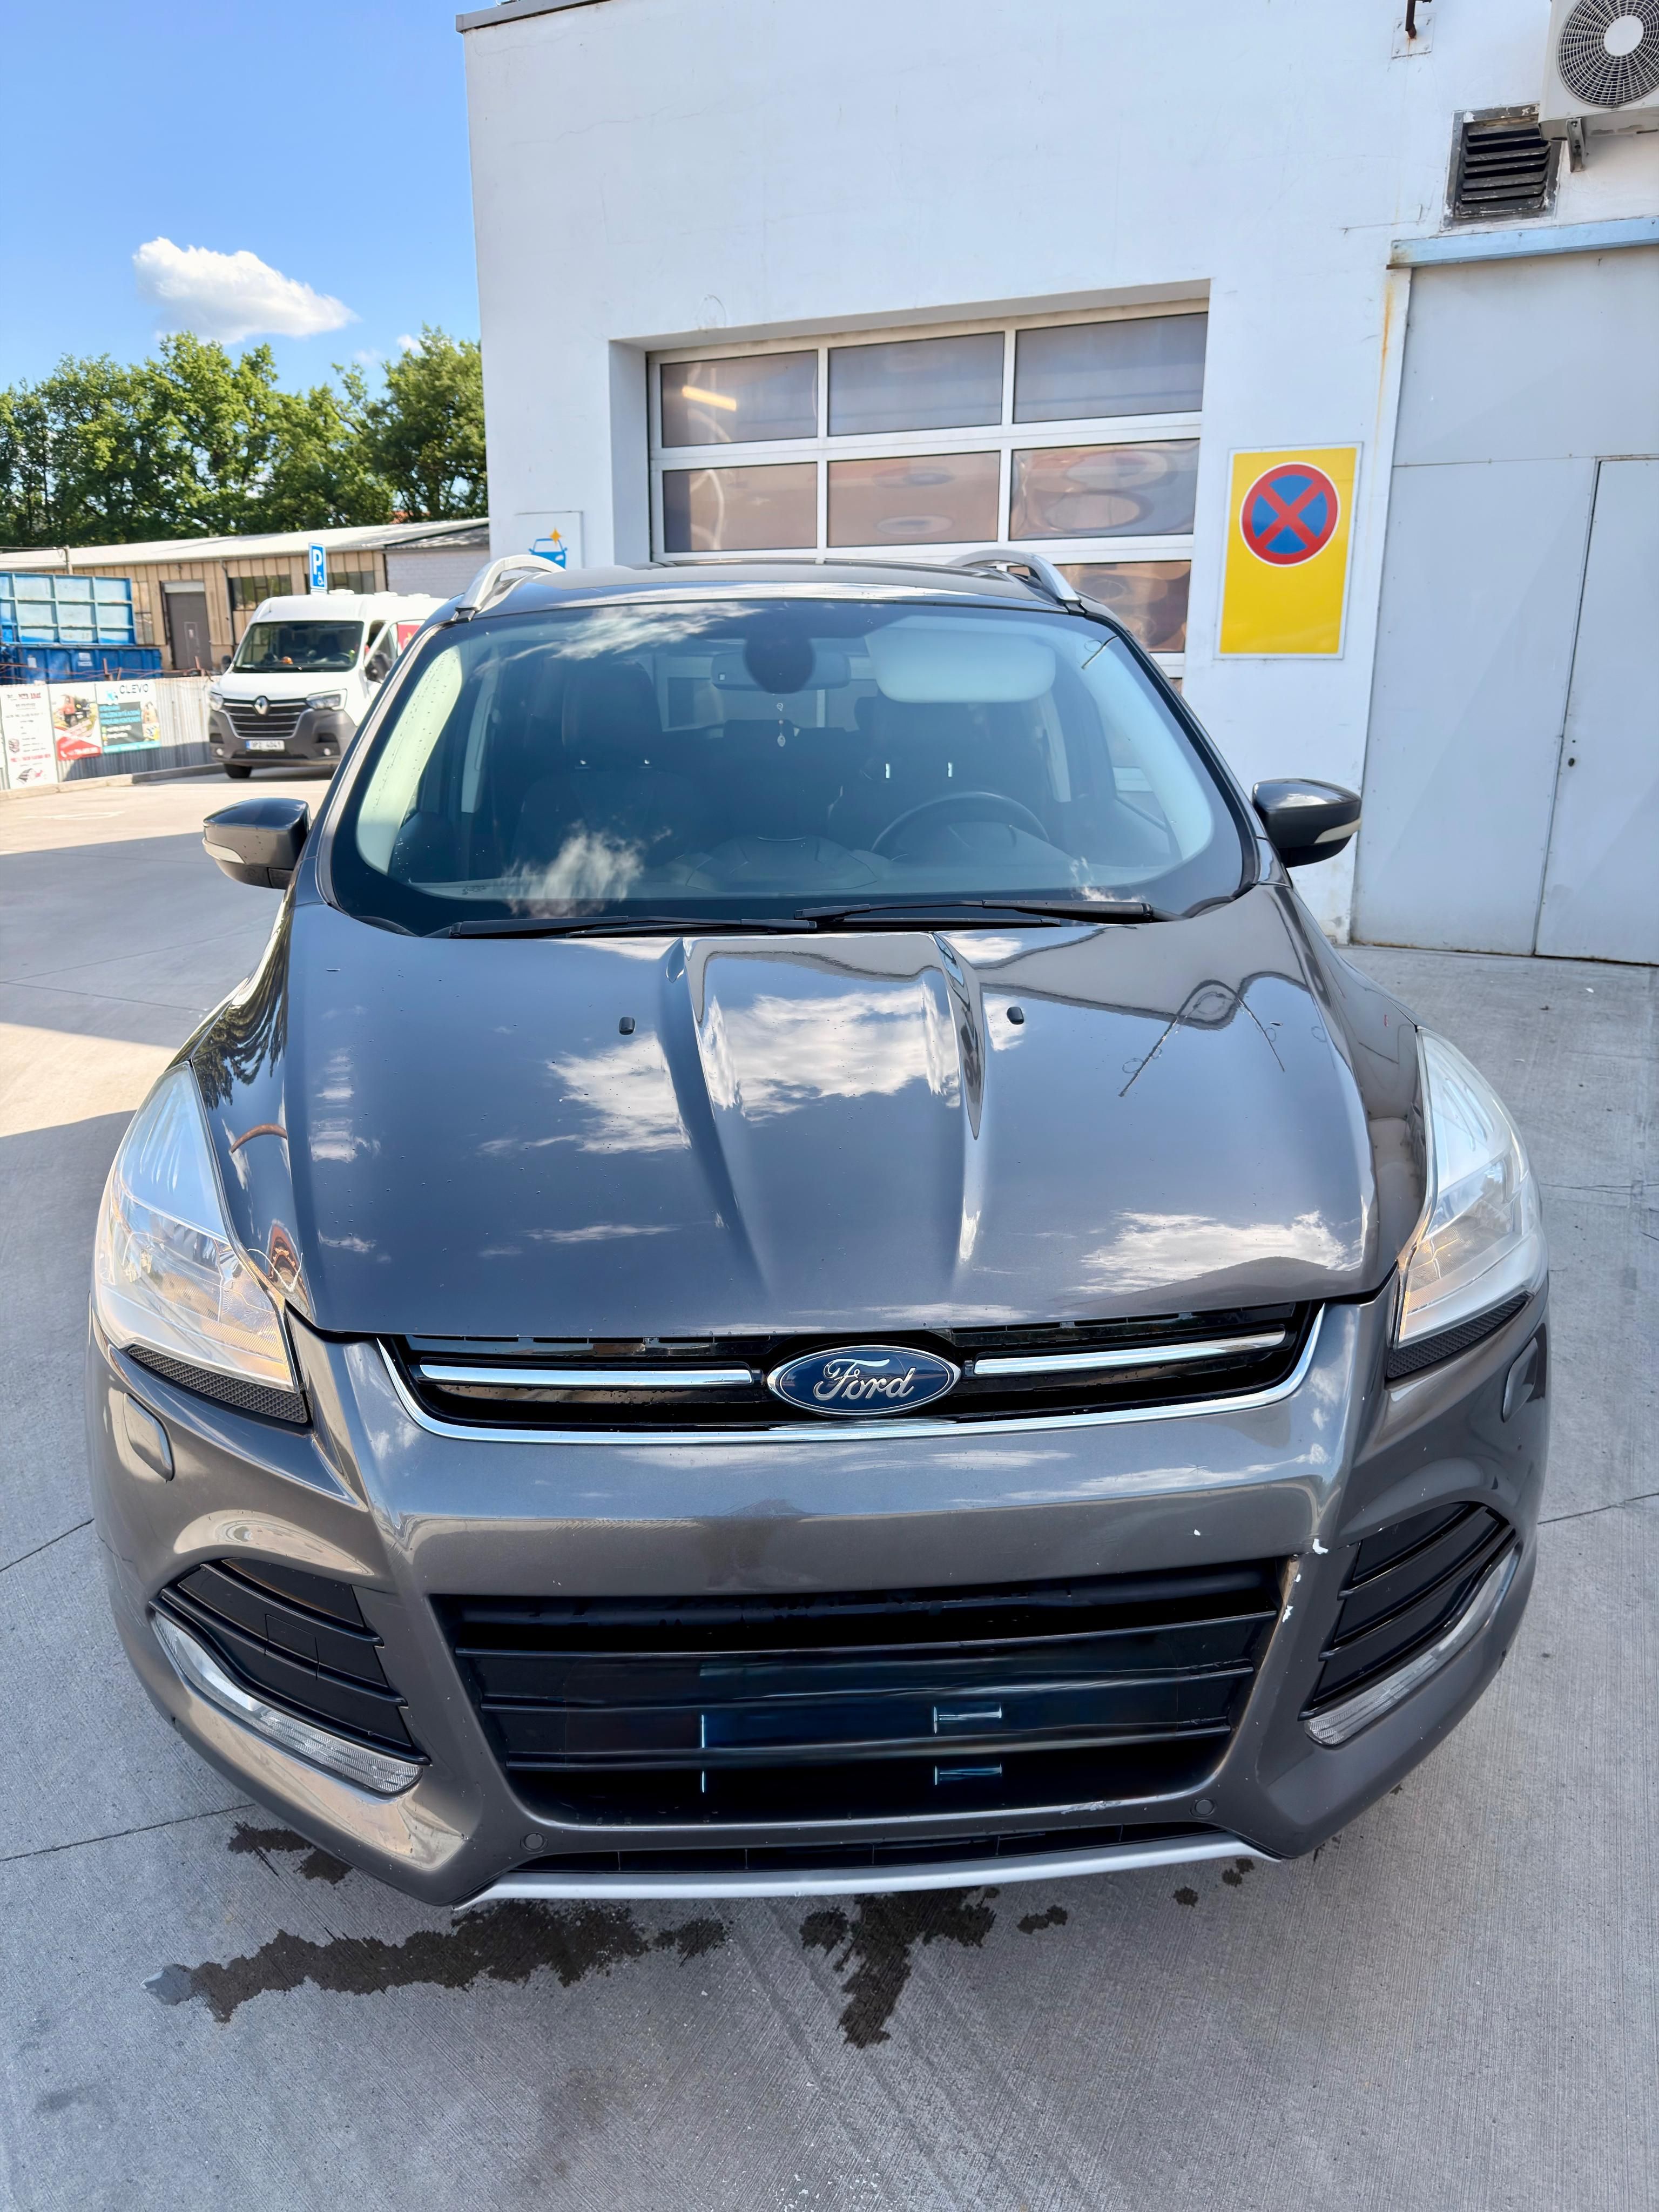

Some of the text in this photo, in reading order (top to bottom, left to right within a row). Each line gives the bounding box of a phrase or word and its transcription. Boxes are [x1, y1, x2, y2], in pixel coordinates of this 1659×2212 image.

[313, 549, 322, 575] P
[119, 684, 149, 694] CLEVO
[813, 1358, 916, 1401] Ford
